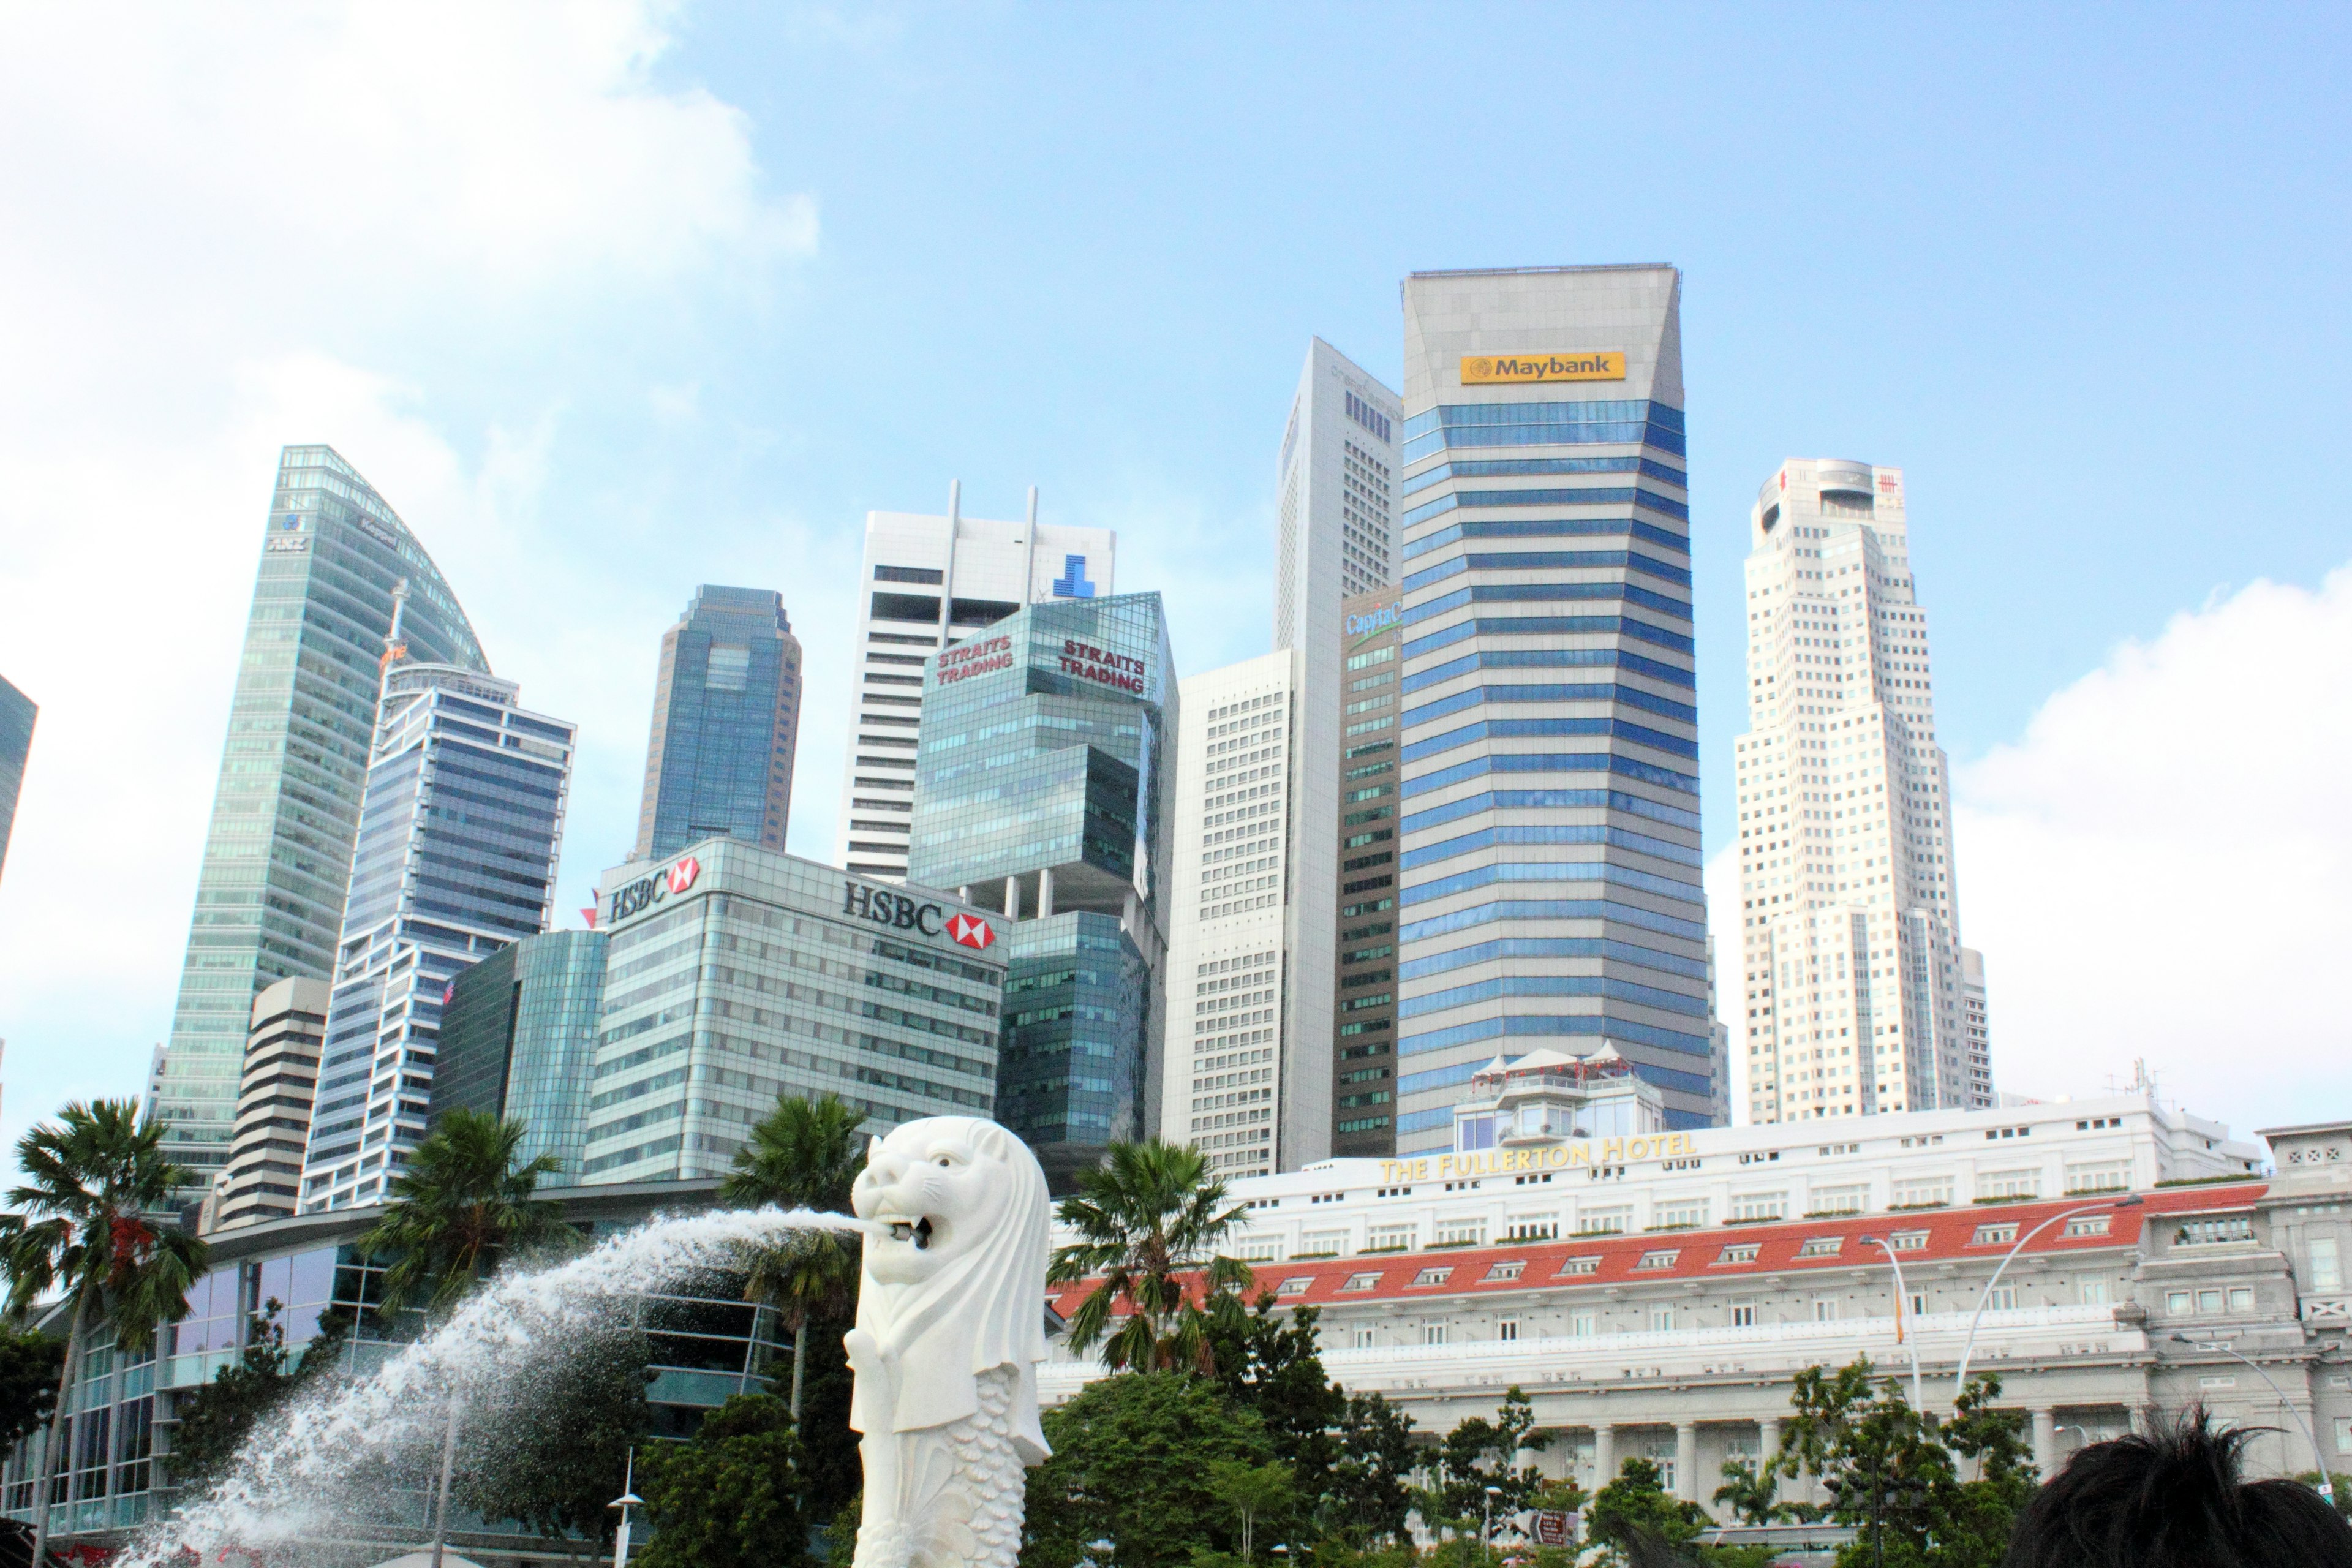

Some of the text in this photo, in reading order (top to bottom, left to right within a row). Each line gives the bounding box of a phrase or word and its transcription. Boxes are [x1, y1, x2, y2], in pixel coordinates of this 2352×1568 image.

[1495, 355, 1610, 379] Maybank
[266, 538, 307, 551] ANZ
[360, 518, 398, 547] Keppel
[937, 652, 1012, 685] TRADING
[938, 635, 1011, 668] STRAITS
[1064, 639, 1144, 675] STRAITS
[1058, 655, 1144, 693] TRADING
[608, 868, 667, 923] HSBC
[843, 881, 941, 936] HSBC
[1379, 1133, 1697, 1183] THE FULLERTON HOTEL
